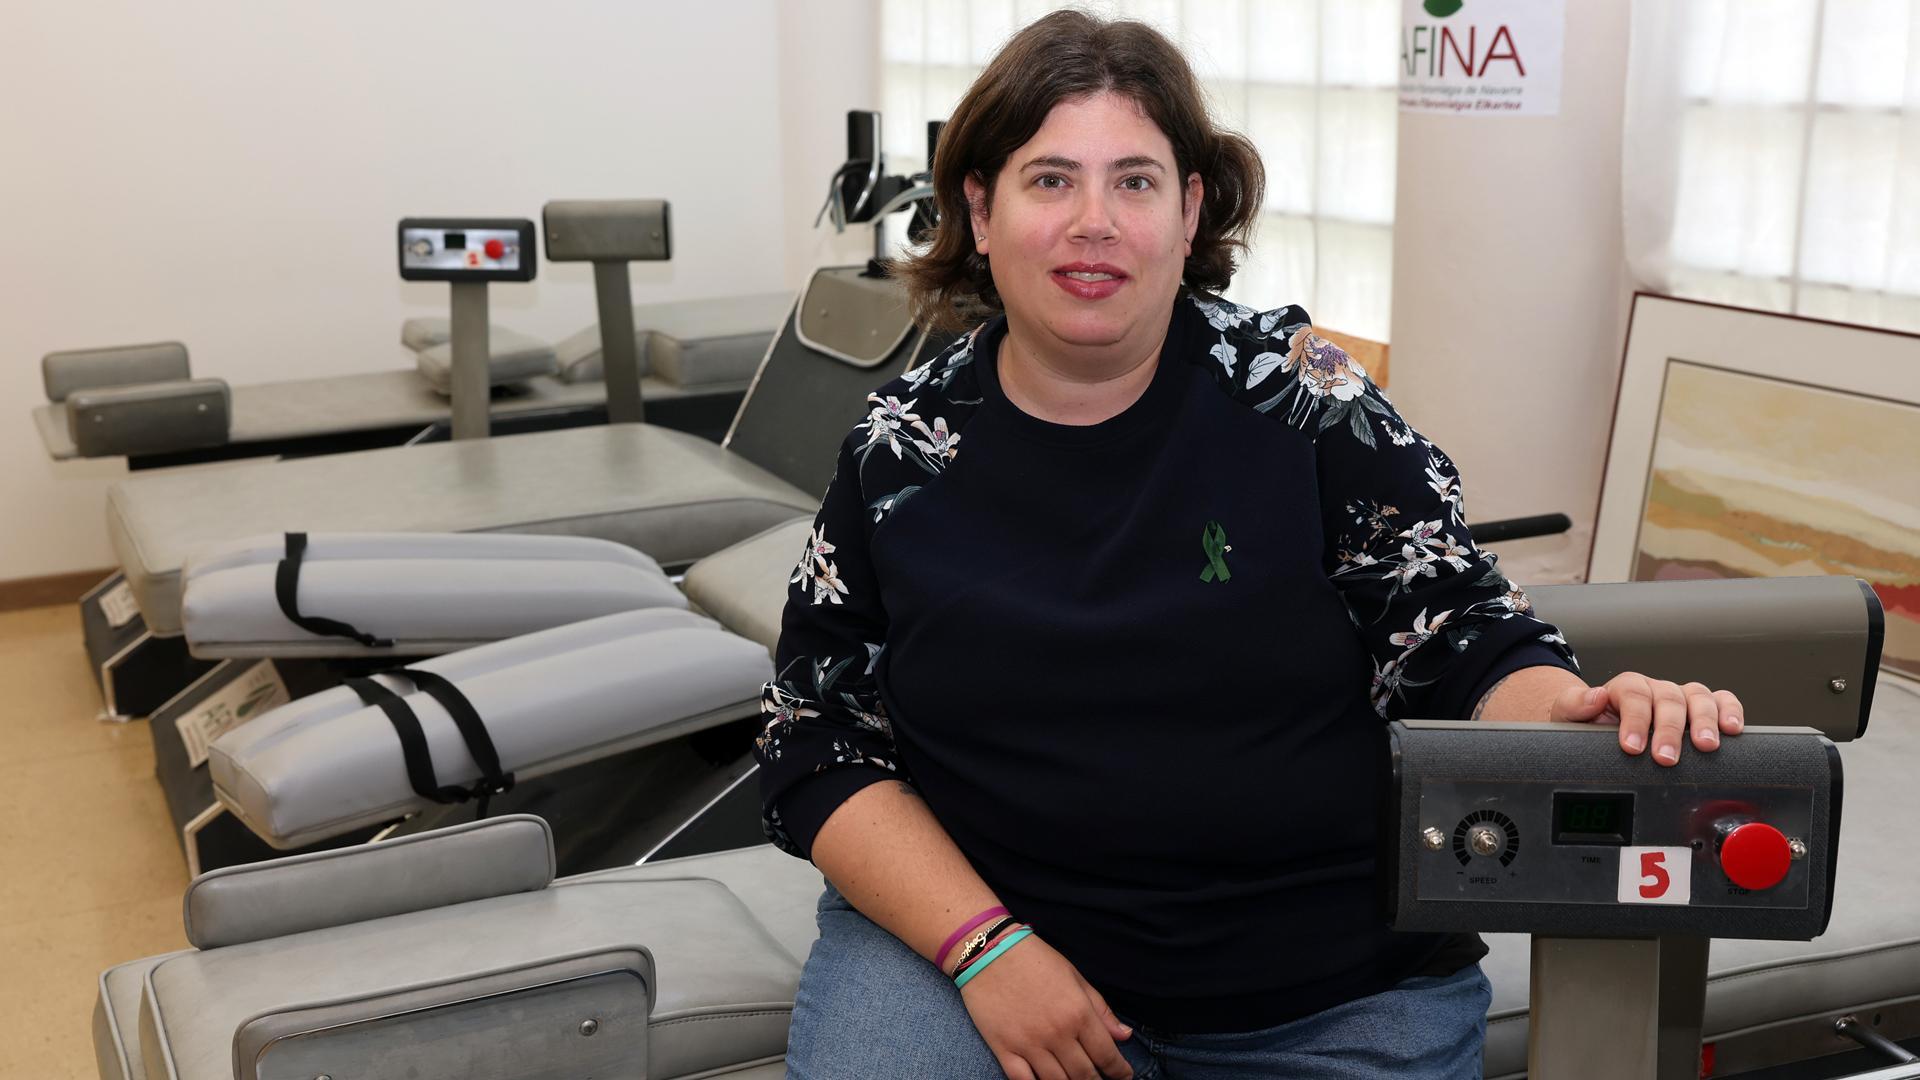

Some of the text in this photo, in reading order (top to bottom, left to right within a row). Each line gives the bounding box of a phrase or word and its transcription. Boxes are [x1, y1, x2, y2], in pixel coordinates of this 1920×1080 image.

[1581, 856, 1601, 864] TIME
[1638, 851, 1670, 898] 5
[1469, 876, 1497, 884] SPEED
